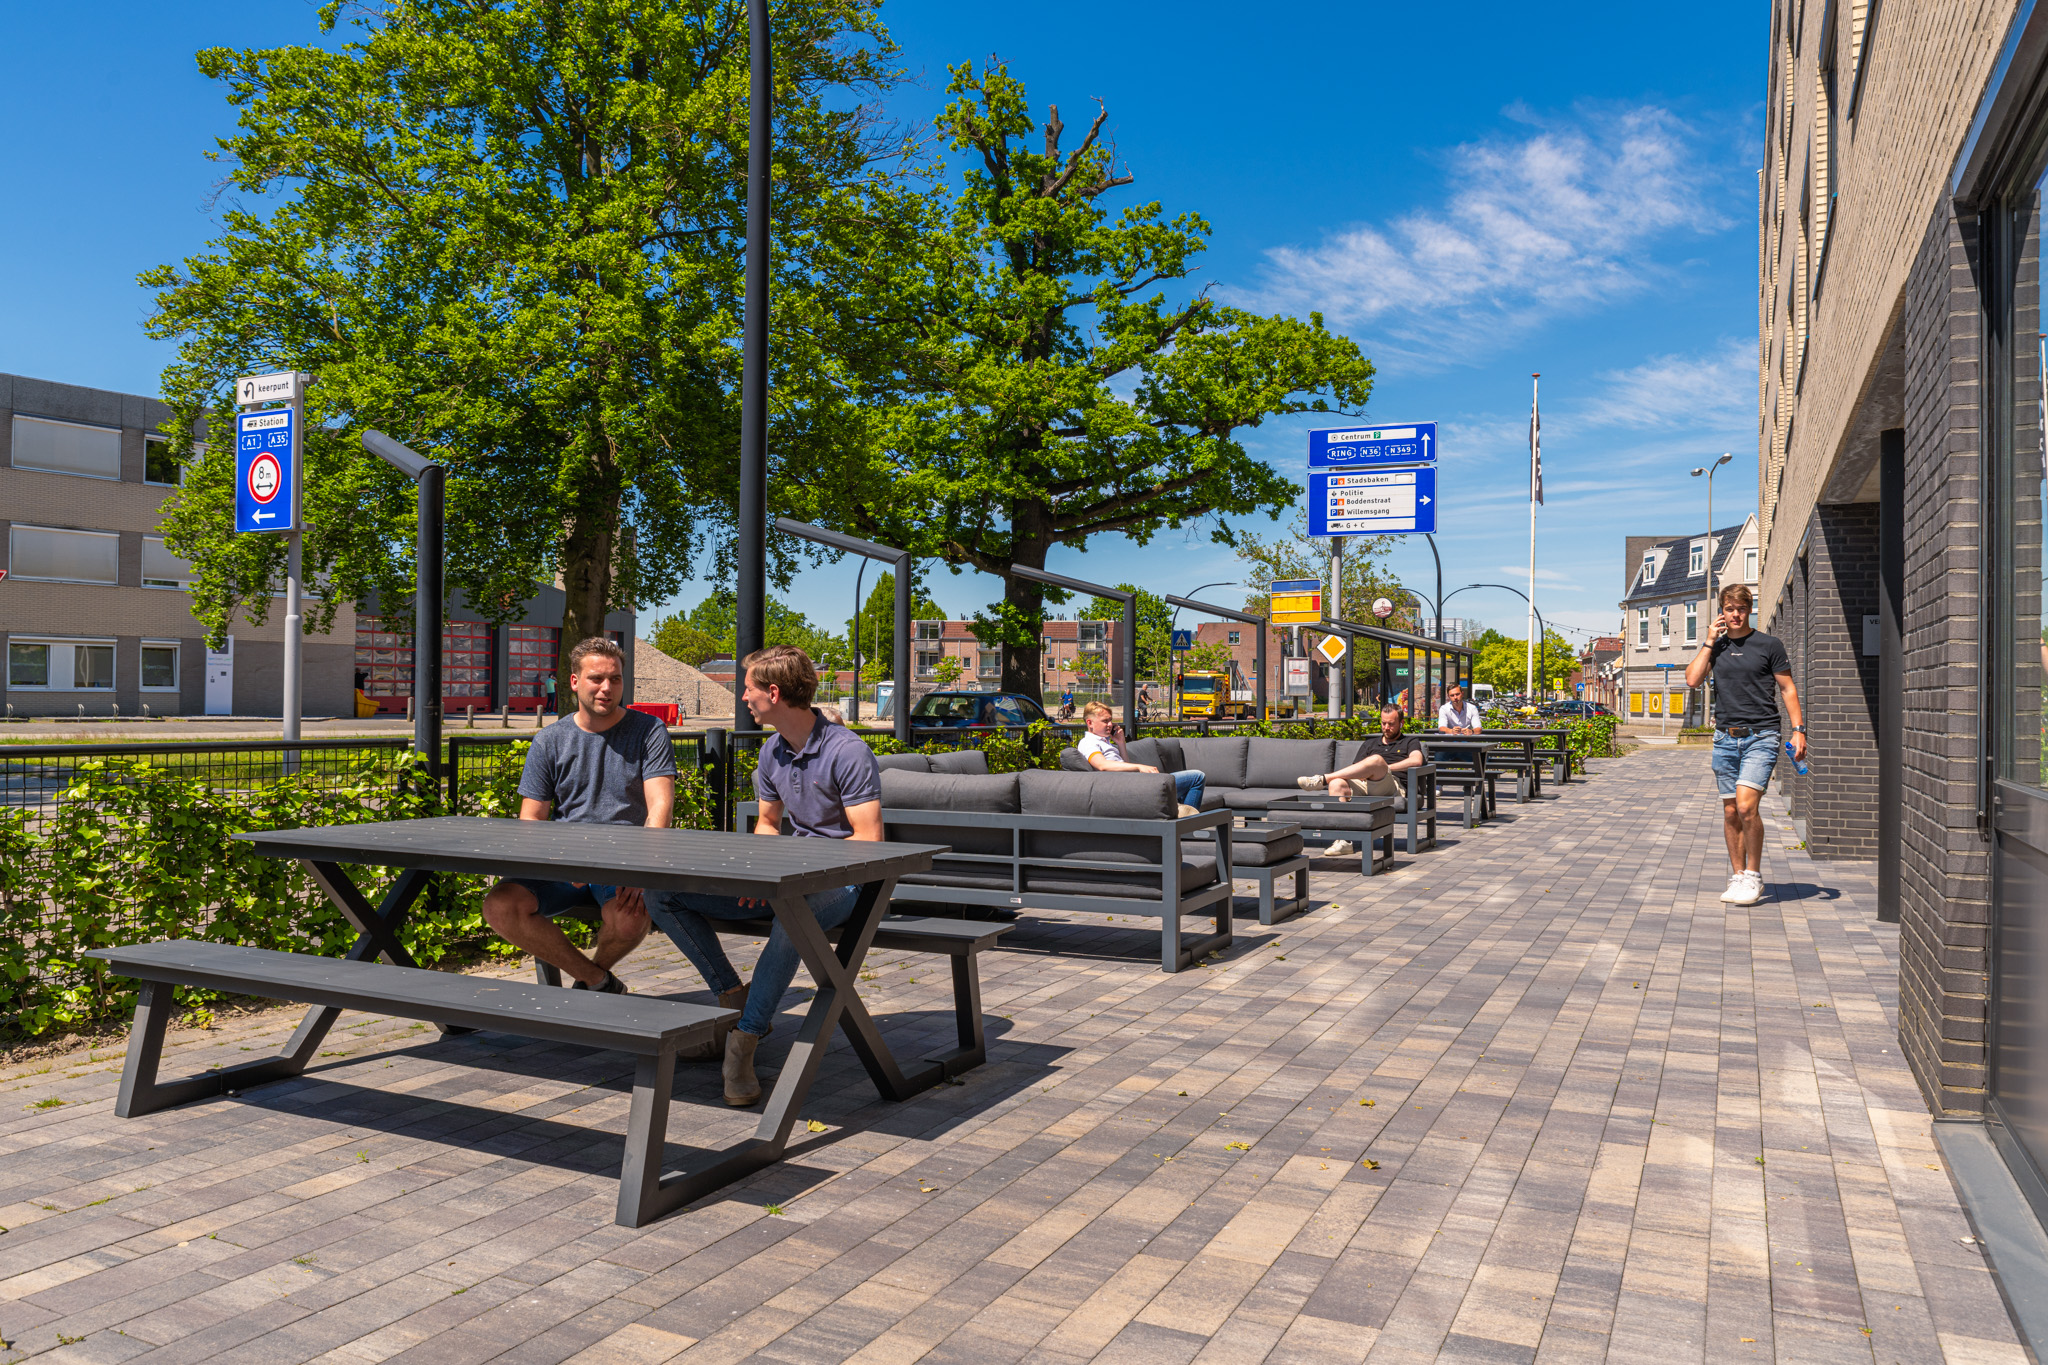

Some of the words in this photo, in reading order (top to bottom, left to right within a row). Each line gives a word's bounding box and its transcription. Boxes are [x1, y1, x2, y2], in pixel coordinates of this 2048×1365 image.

[258, 381, 289, 392] keerpunt
[259, 418, 284, 427] Station
[1347, 476, 1389, 484] Stadsbaken
[1346, 497, 1391, 505] Boddenstraat
